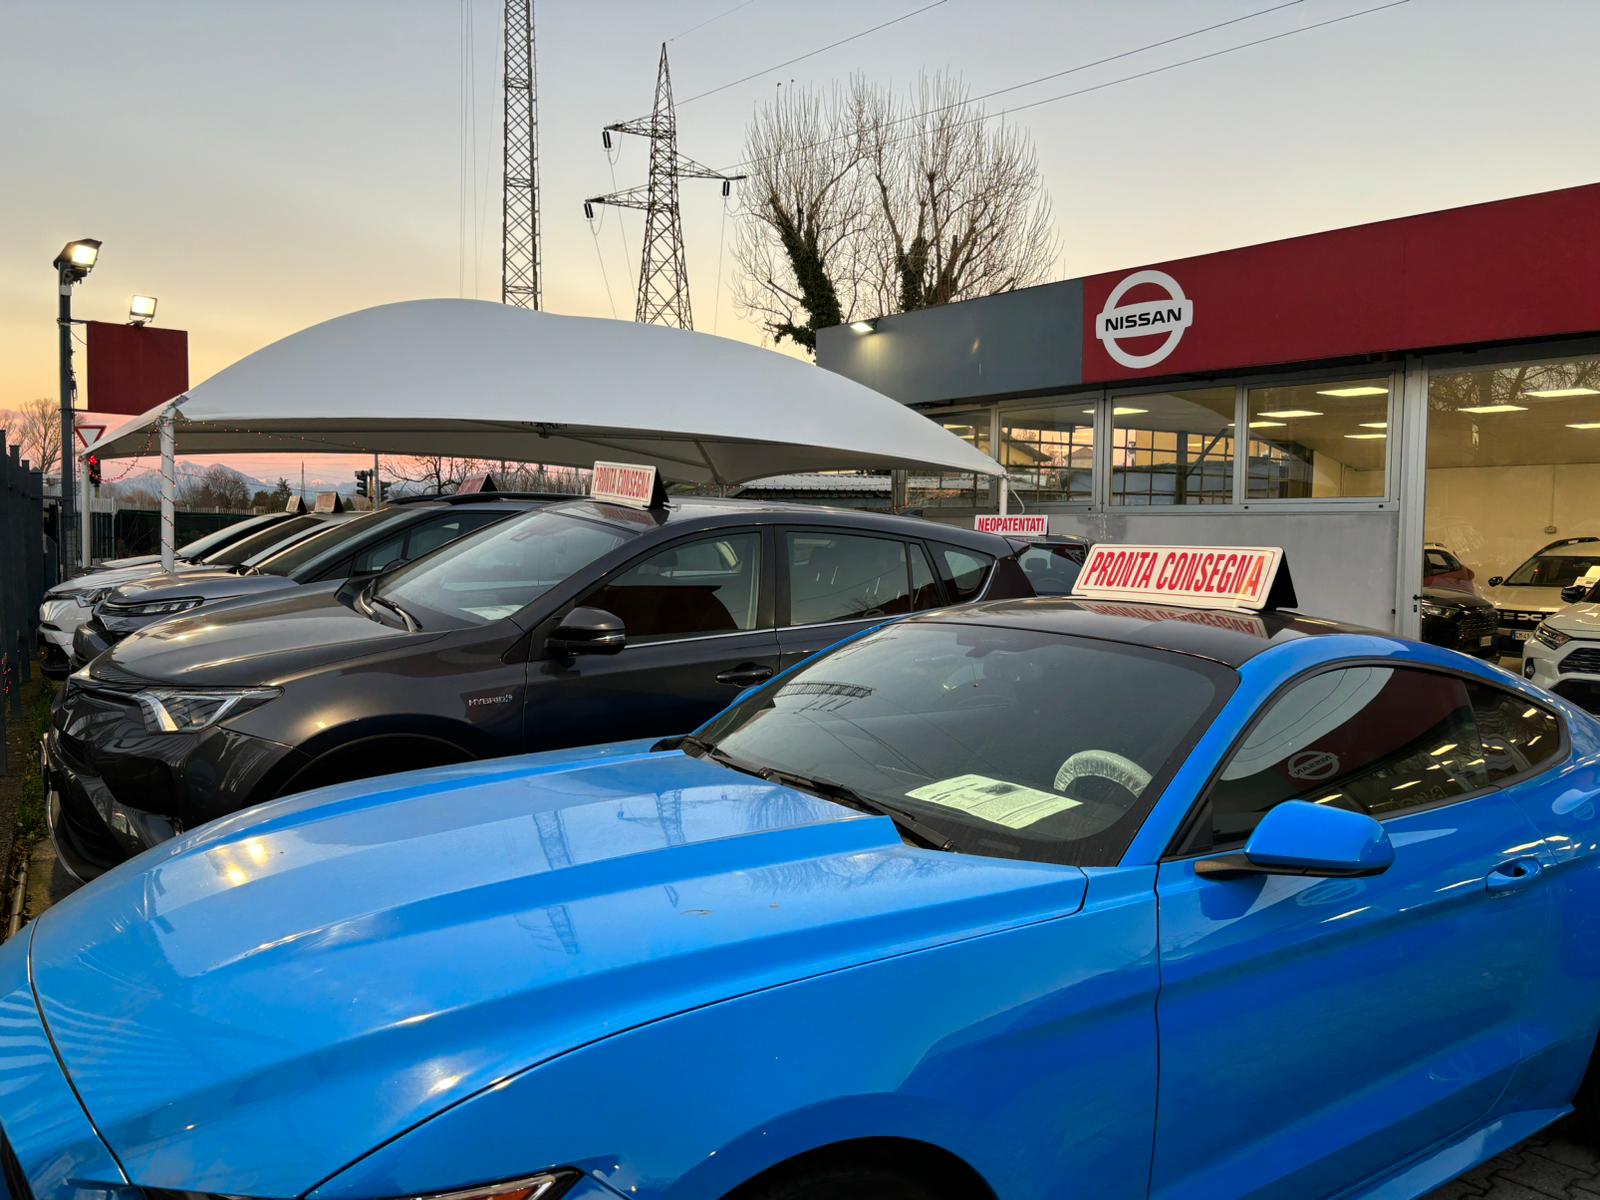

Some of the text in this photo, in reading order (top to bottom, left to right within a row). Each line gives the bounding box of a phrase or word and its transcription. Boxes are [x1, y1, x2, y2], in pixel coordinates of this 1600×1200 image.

[1105, 307, 1182, 332] NISSAN
[594, 466, 651, 498] PRONTA CONSEGNA
[978, 517, 1045, 532] NEOPATENTATI
[1084, 551, 1266, 597] PRONTA CONSEGNA
